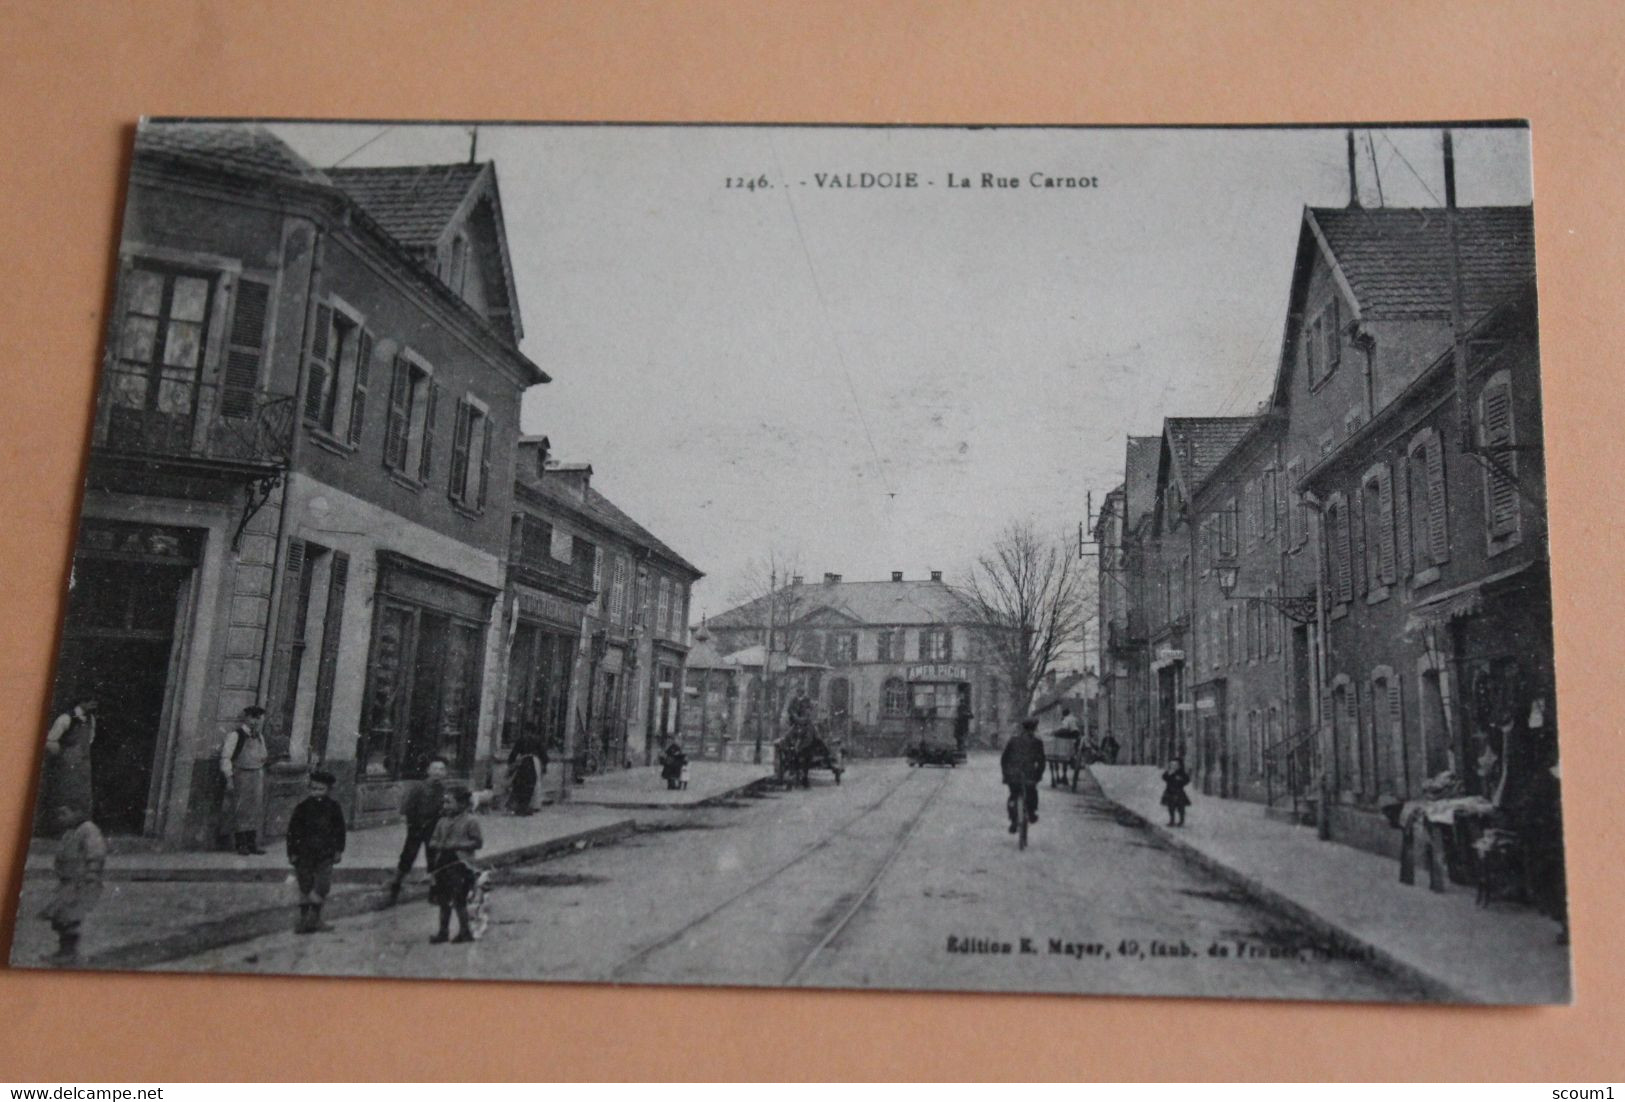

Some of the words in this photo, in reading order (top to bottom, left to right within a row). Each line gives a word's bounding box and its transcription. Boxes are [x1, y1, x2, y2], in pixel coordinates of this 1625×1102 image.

[814, 172, 919, 189] VALDOIE
[948, 172, 971, 189] La
[981, 172, 1020, 189] Rue
[1029, 171, 1099, 189] Carnot
